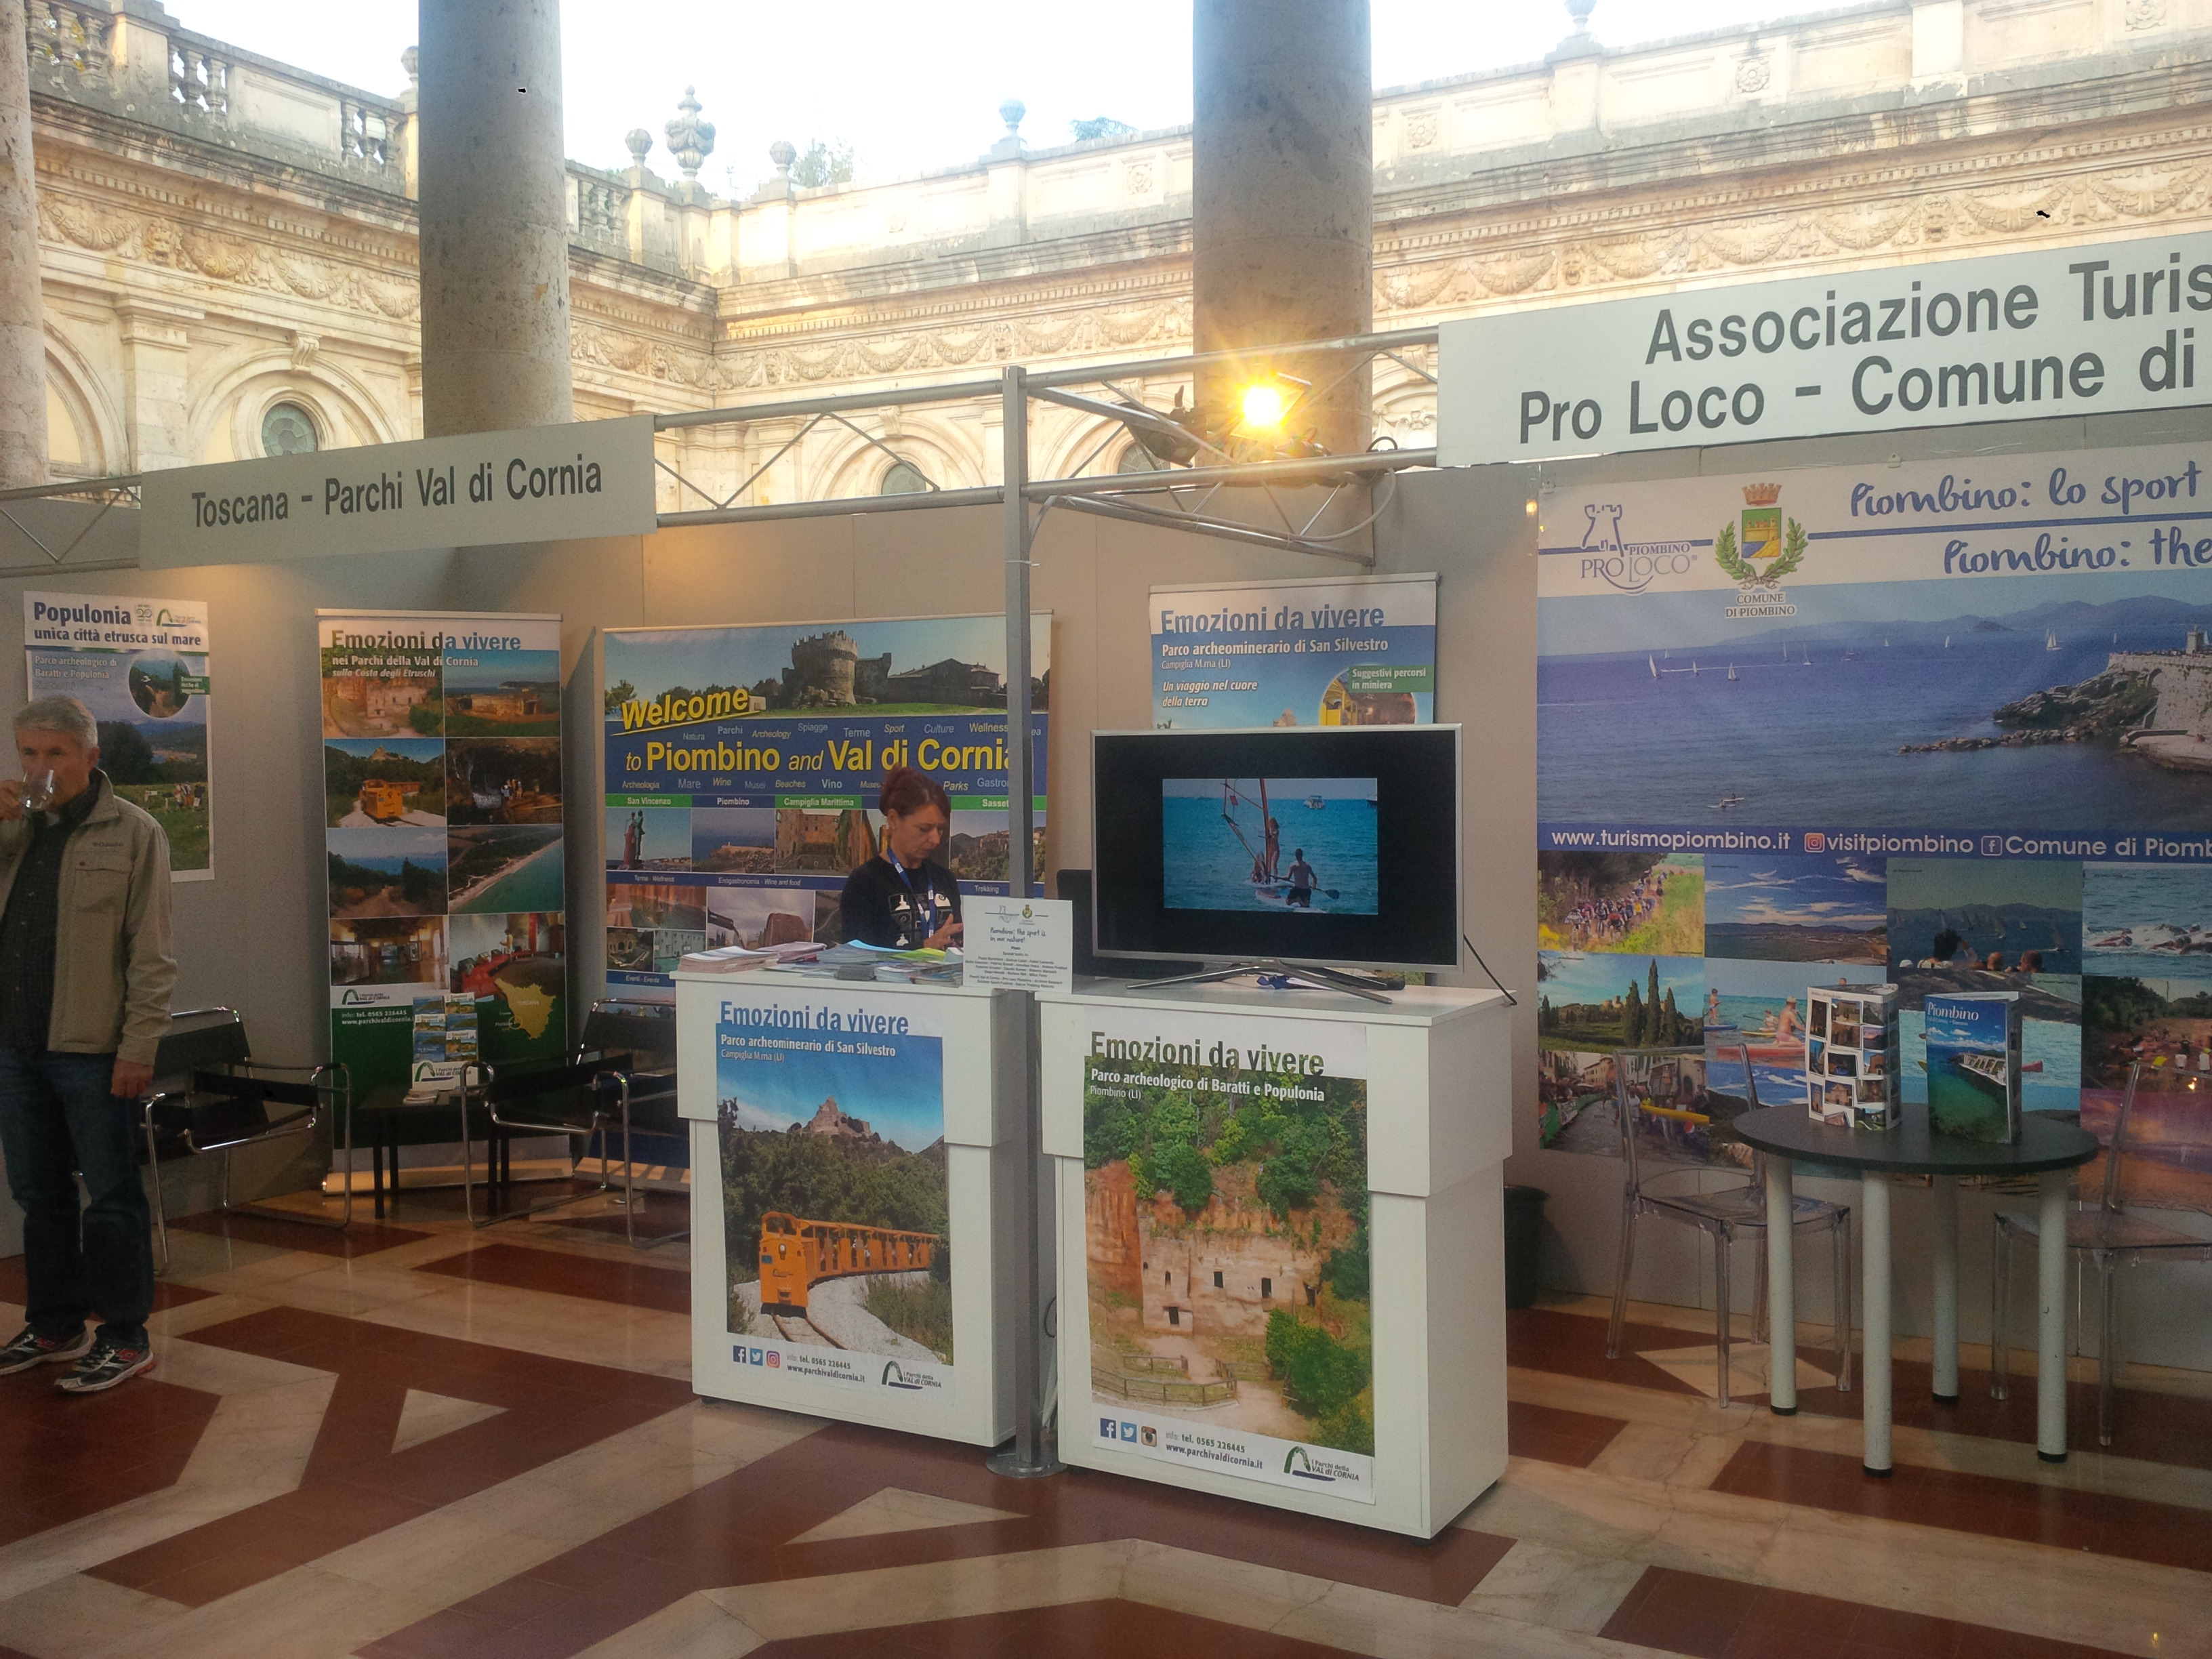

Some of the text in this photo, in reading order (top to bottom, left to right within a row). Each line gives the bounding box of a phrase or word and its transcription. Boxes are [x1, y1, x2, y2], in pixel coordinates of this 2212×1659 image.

[1645, 253, 2212, 365] Associazione Turis
[1520, 390, 1602, 444] Pro
[1629, 380, 1763, 434] Loco
[1851, 351, 2104, 415] Comune
[2139, 328, 2194, 391] di
[192, 453, 602, 528] Toscana Parchi Val di Cornia
[1851, 460, 2202, 517] Piombino: lo sport
[1629, 544, 1691, 555] PIOMBINO
[1944, 526, 2212, 574] Piombino: the
[1581, 558, 1624, 579] PRO
[1737, 594, 1784, 604] COMUNE
[35, 601, 131, 626] Populonia
[1161, 603, 1384, 634] Emozioni da vivere
[1726, 606, 1795, 617] DI PIOMBINO
[35, 628, 201, 645] unica città etrusca sul mare
[331, 630, 522, 651] Emozioni da vivere
[1162, 637, 1389, 657] Parco archeominerario di San Silvestro
[35, 655, 117, 668] Parco archeologico di
[332, 655, 478, 667] nei Parchi della Val di Cornia
[1162, 657, 1231, 670] Campiglia M.ma (LI)
[70, 670, 109, 680] Populonia
[332, 668, 436, 679] sulla Costa degli Etruschi
[1352, 668, 1426, 680] Suggestivi percorsi
[1163, 680, 1257, 694] Un viaggio nel cuore
[1352, 679, 1392, 689] in miniera
[621, 687, 750, 731] Welcome
[1162, 696, 1208, 708] della terra
[683, 722, 1008, 741] Natura Parchi Archeology Spiagge Terme Sport Culture Wellness
[626, 737, 1010, 772] to Piombino and Val di Corni
[622, 777, 968, 792] Archeologia Mare Wine Musei Beaches Vino Parks
[627, 797, 671, 805] San Vincenzo
[717, 797, 750, 805] Piombino
[784, 798, 854, 807] Campiglia Marittima
[1552, 830, 1790, 851] www.turismopiombino.it
[1827, 833, 1974, 855] visitpiombino
[2005, 836, 2106, 855] Comune
[2115, 838, 2135, 856] di
[975, 885, 1000, 894] Trekking
[720, 1001, 909, 1036] Emozioni da vivere
[1927, 1002, 1979, 1021] Piombino
[721, 1033, 896, 1057] Parco archeominerario di San Silvestro
[721, 1049, 752, 1061] Campiglia
[754, 1051, 773, 1061] M.ma
[1091, 1031, 1324, 1076] Emozioni da vivere
[1090, 1085, 1142, 1101] Piombino (LI)
[1091, 1068, 1325, 1102] Parco archeologico di Baratti e Populonia
[811, 1357, 826, 1366] 0565
[828, 1360, 851, 1370] 226445
[787, 1365, 865, 1382] www.parchivaldicornia.it
[921, 1380, 941, 1388] CORNIA
[1182, 1434, 1194, 1443] tel.
[1197, 1437, 1214, 1447] 0565
[1217, 1441, 1245, 1453] 226445
[1166, 1443, 1263, 1469] www.parchivaldicornia.it
[1315, 1460, 1333, 1469] Parchi
[1312, 1466, 1324, 1474] VAL
[1333, 1471, 1359, 1481] CORNIA
